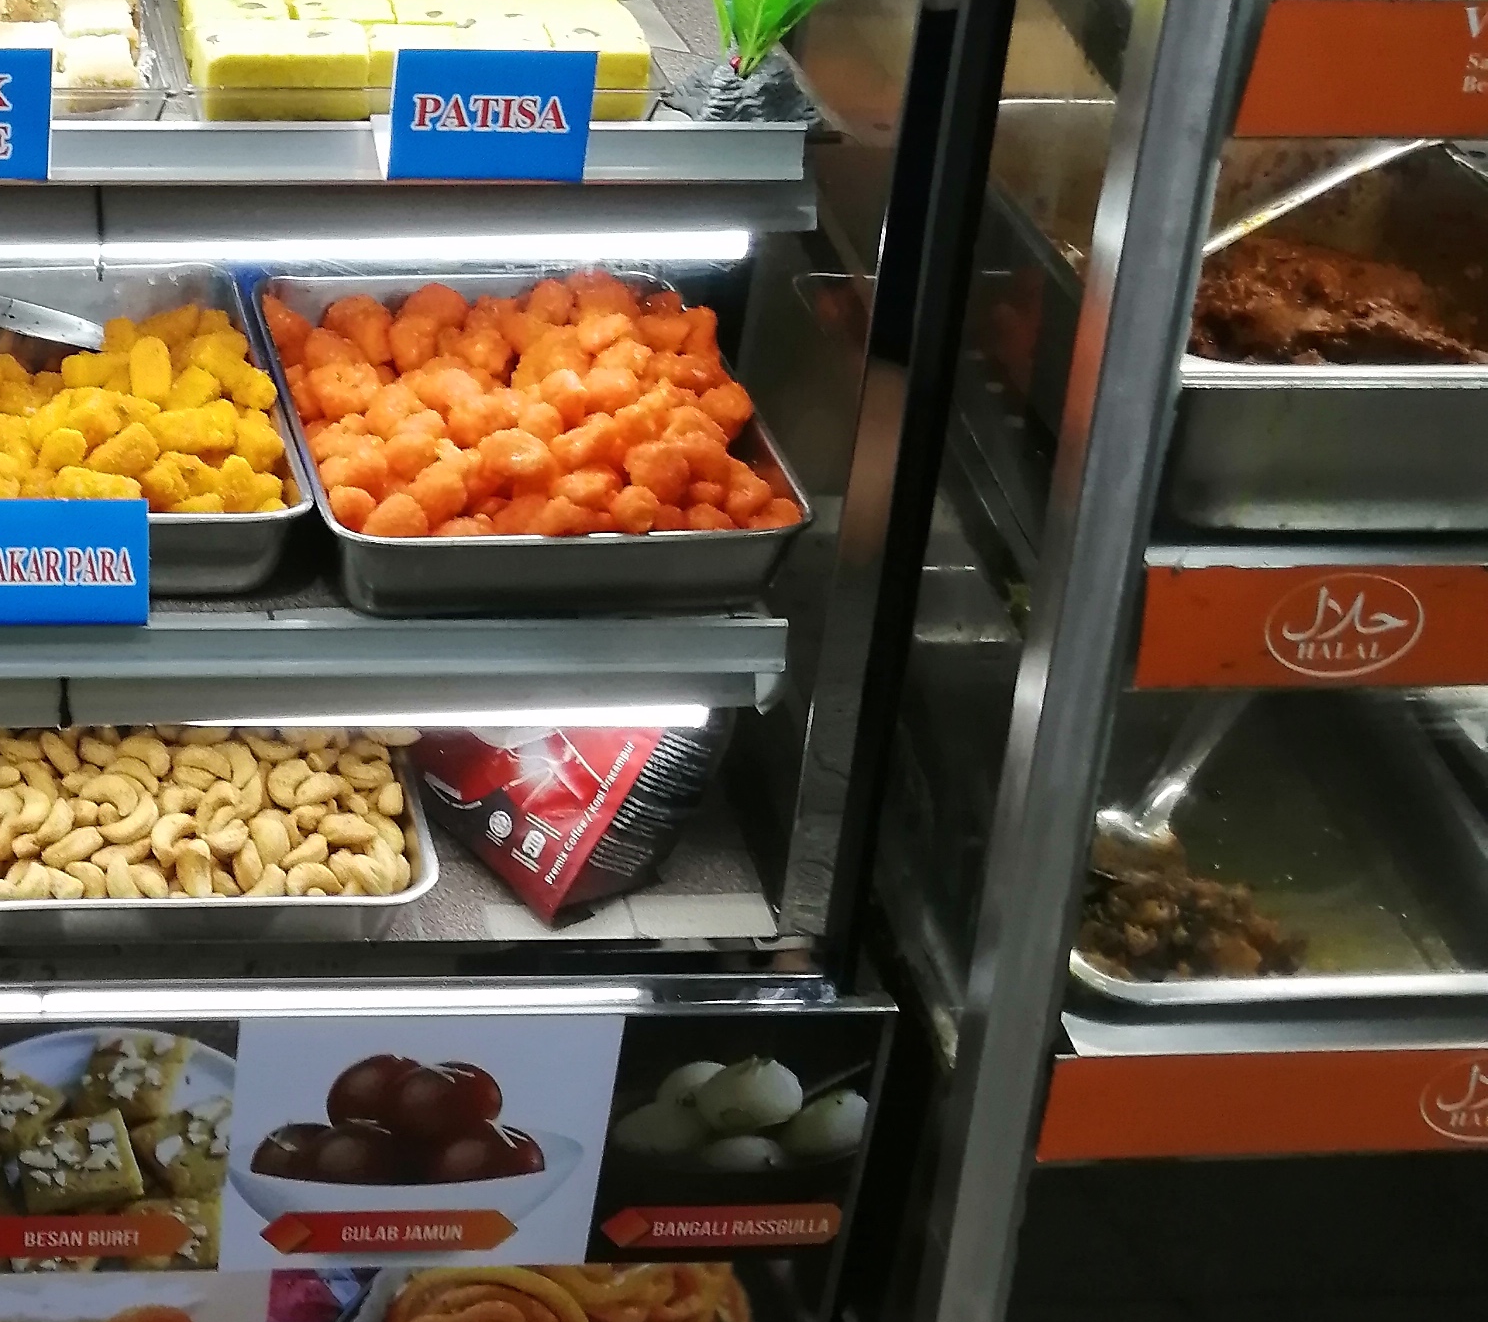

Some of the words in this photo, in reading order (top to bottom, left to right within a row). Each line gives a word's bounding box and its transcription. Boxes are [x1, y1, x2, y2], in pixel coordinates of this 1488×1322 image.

[413, 95, 568, 131] PATISA
[64, 548, 135, 584] PARA
[1297, 641, 1384, 660] HALAL
[341, 1226, 399, 1242] GULAB
[402, 1225, 463, 1241] JAMUN
[652, 1221, 727, 1236] BANGALI
[731, 1219, 829, 1234] RASSGULLA
[24, 1230, 83, 1247] BESAN
[87, 1230, 140, 1246] BURFI
